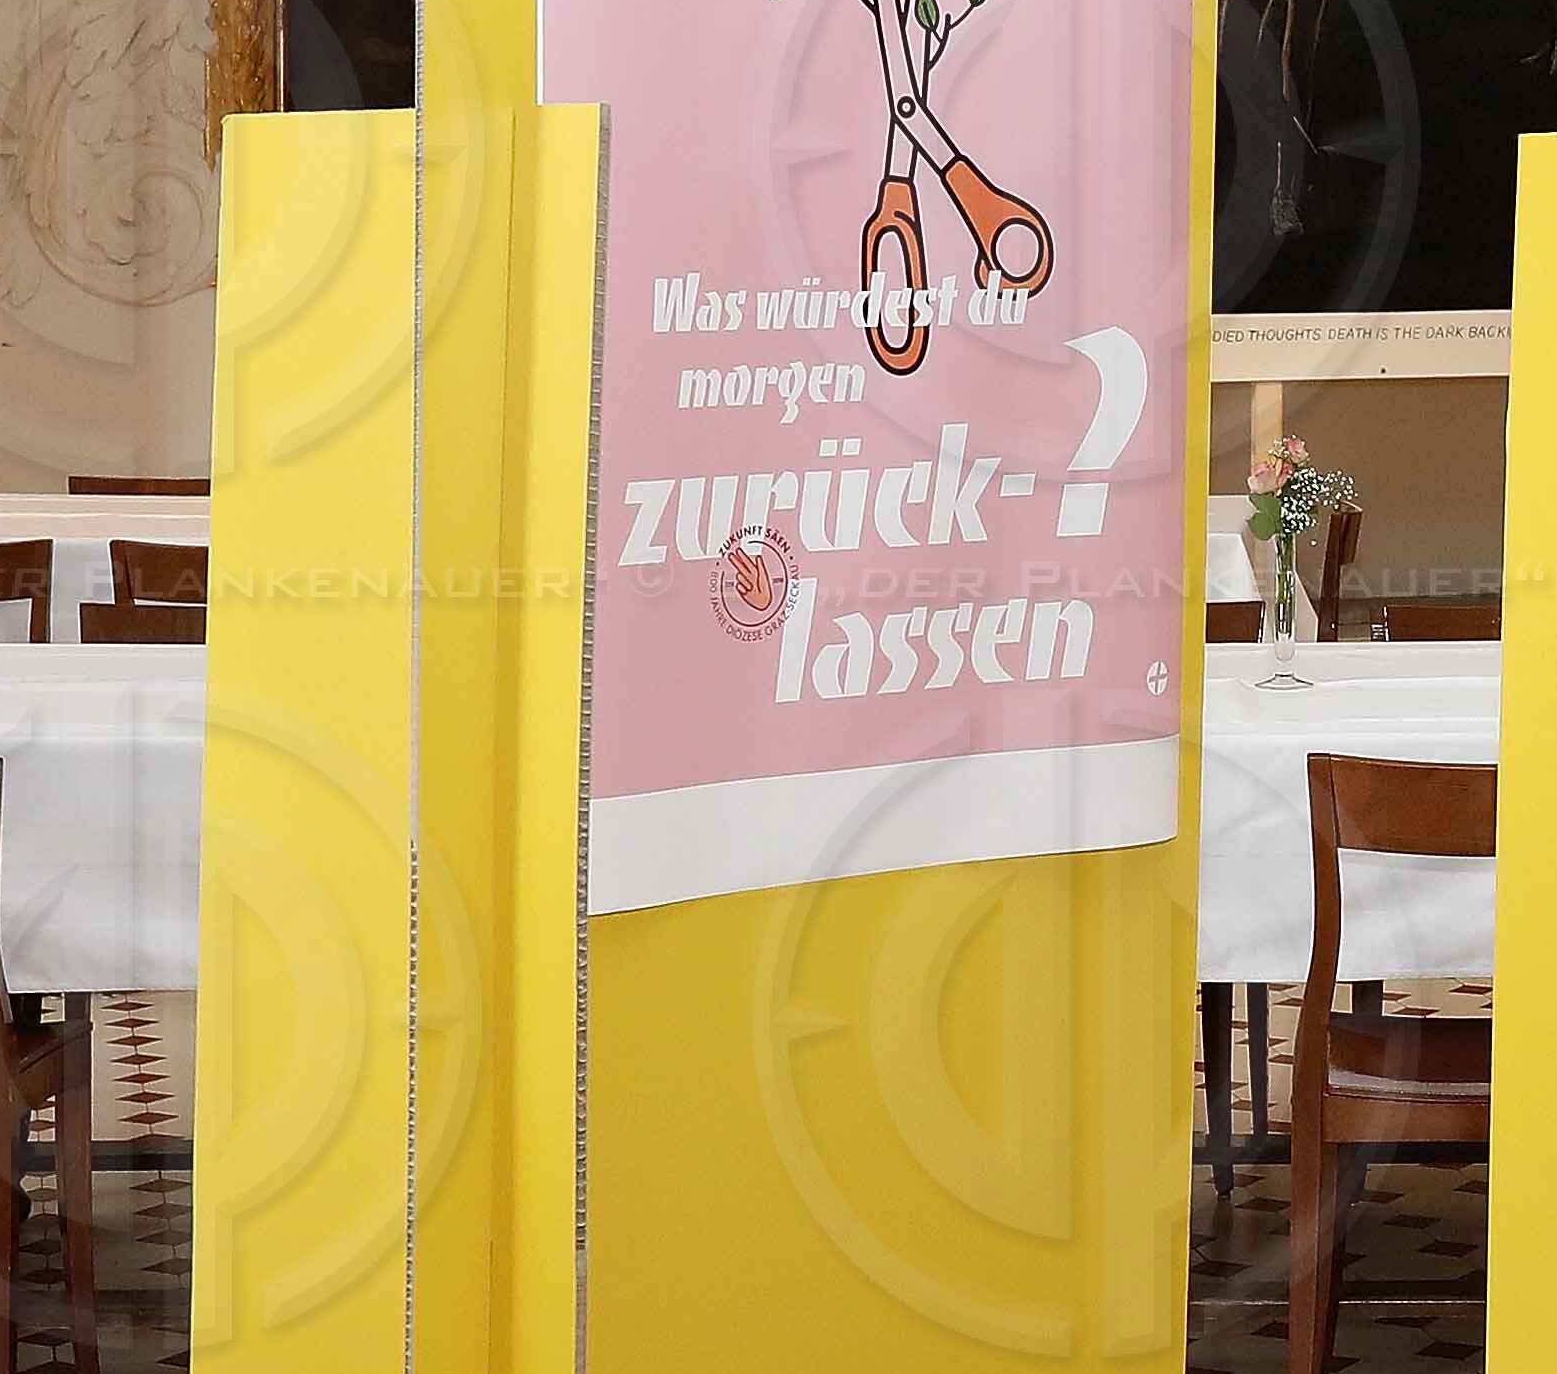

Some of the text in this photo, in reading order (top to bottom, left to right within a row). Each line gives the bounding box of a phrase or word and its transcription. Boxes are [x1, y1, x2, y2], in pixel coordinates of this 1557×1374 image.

[652, 269, 1031, 333] Was würdest du
[1248, 328, 1321, 342] THOUGHTS
[1328, 328, 1371, 341] DEATH
[1375, 327, 1388, 340] IS
[1394, 326, 1421, 340] THE
[1426, 325, 1464, 339] DARK
[678, 360, 866, 424] morgen
[618, 423, 1036, 567] zurück-
[718, 525, 791, 558] ZUKUNFT SÄEN
[774, 576, 1095, 704] lassen
